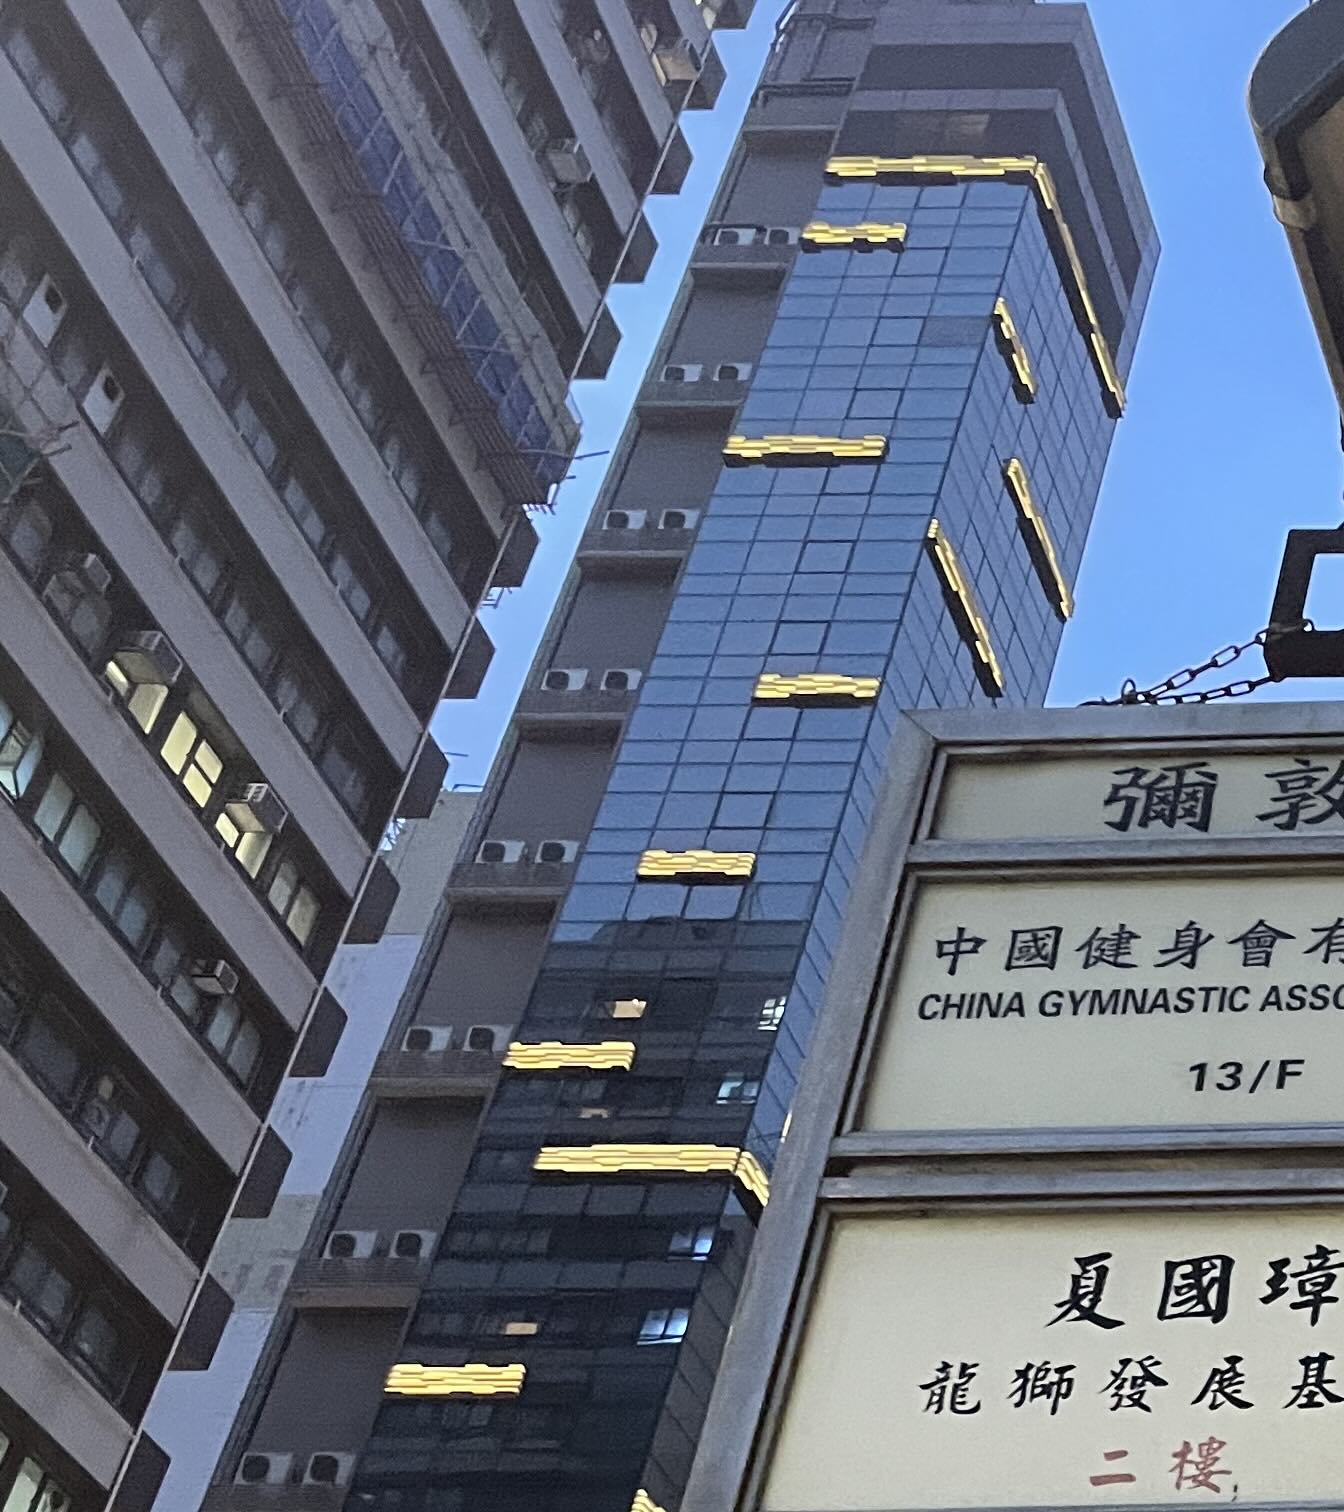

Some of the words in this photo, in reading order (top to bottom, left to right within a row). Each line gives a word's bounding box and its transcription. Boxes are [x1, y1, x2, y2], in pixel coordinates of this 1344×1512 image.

[918, 993, 1026, 1021] CHINA
[1038, 985, 1252, 1018] GYMNASTIC
[1189, 1058, 1306, 1095] 13/F
[1089, 1437, 1234, 1494] 二樓
